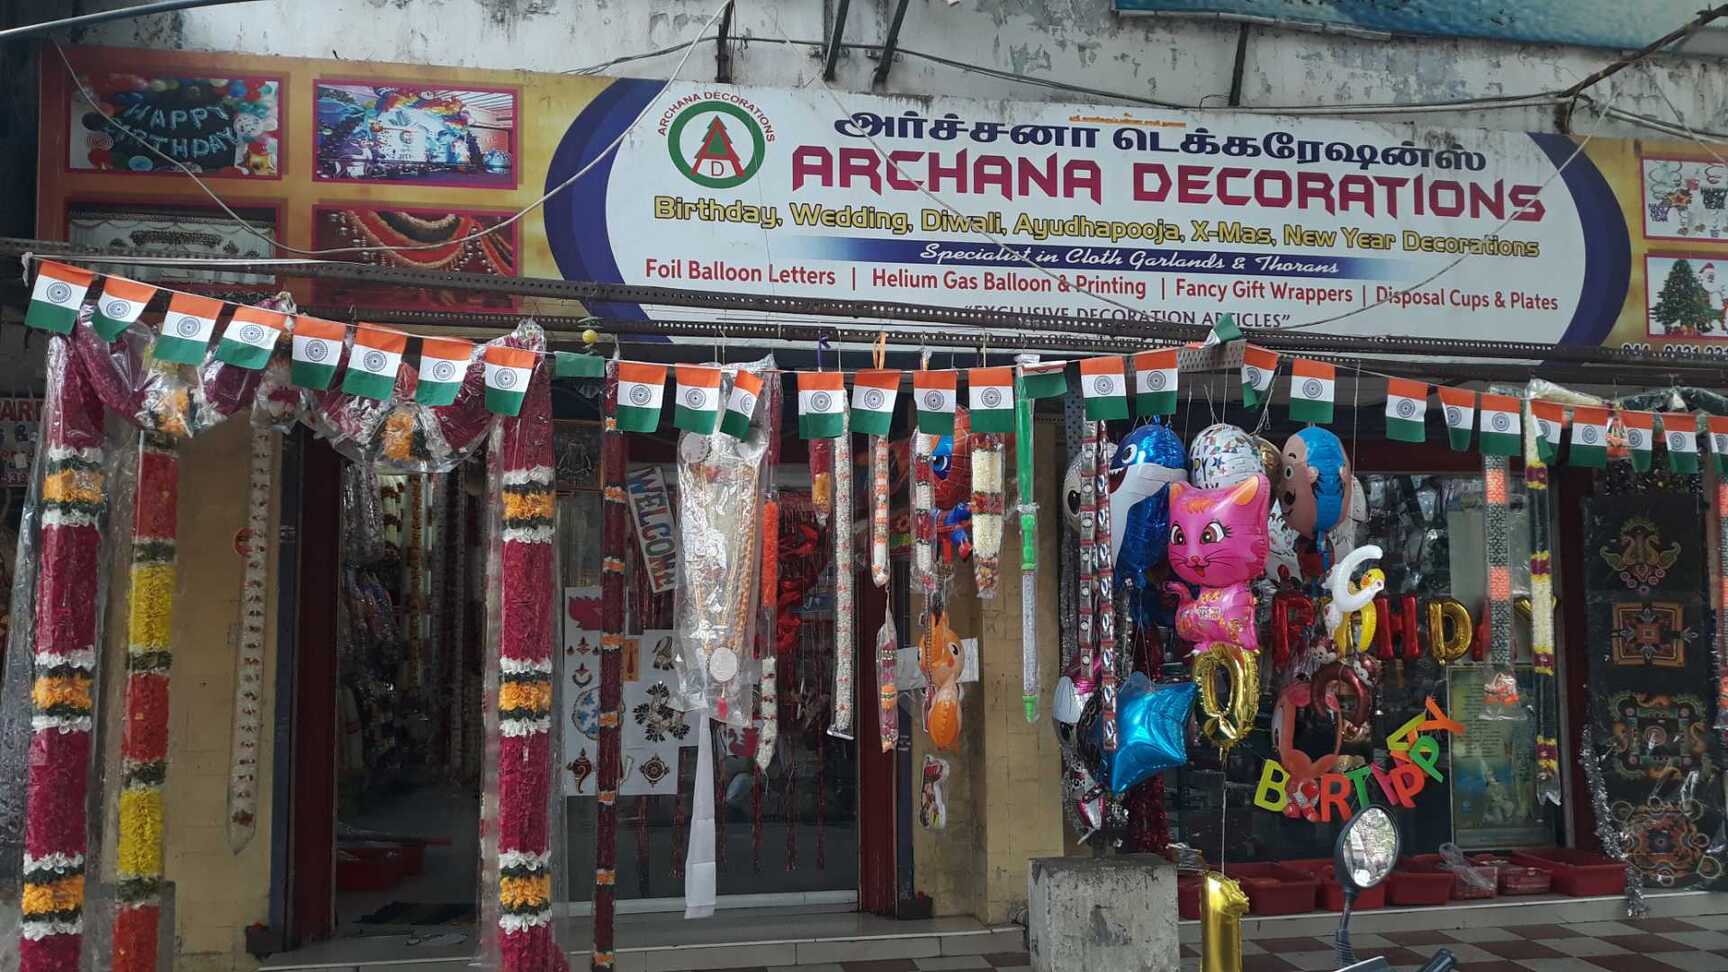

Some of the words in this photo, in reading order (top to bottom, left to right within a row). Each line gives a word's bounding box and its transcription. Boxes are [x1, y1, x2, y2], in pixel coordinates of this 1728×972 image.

[658, 93, 702, 136] ARCHANA
[704, 91, 775, 142] DECORATIONS
[834, 110, 1100, 148] அர்ச்சனா
[1113, 127, 1486, 171] டெக்கரேஷன்ஸ்
[792, 145, 1102, 206] ARCHANA
[1133, 162, 1546, 222] DECORATIONS
[654, 195, 783, 229] Birthday,
[789, 202, 913, 235] Wedding,
[921, 208, 1007, 236] Diwali,
[1013, 212, 1185, 244] Ayudhapooja,
[1191, 220, 1277, 247] X-Mas,
[1284, 224, 1337, 247] New
[1341, 227, 1396, 250] Year
[1402, 229, 1540, 257] Decorations
[646, 258, 682, 279] Foil
[688, 260, 762, 282] Balloon
[769, 263, 836, 285] Letters
[873, 268, 937, 289] Helium
[943, 271, 977, 290] Gas
[984, 272, 1051, 292] Balloon
[1058, 274, 1070, 292] &
[1076, 275, 1146, 299] Printing
[1176, 278, 1227, 302] Fancy
[1233, 280, 1265, 300] Gift
[1270, 282, 1352, 305] Wrappers
[1376, 286, 1445, 309] Disposal
[1450, 289, 1489, 311] Cups
[1495, 291, 1506, 308] &
[1511, 292, 1558, 310] Plates
[920, 243, 1032, 264] Specialist
[1036, 250, 1059, 262] in
[1065, 248, 1122, 265] Cloth
[1129, 251, 1225, 269] Garlands
[1232, 257, 1245, 270] &
[1255, 256, 1340, 273] Thorans
[627, 464, 677, 592] WELCOME
